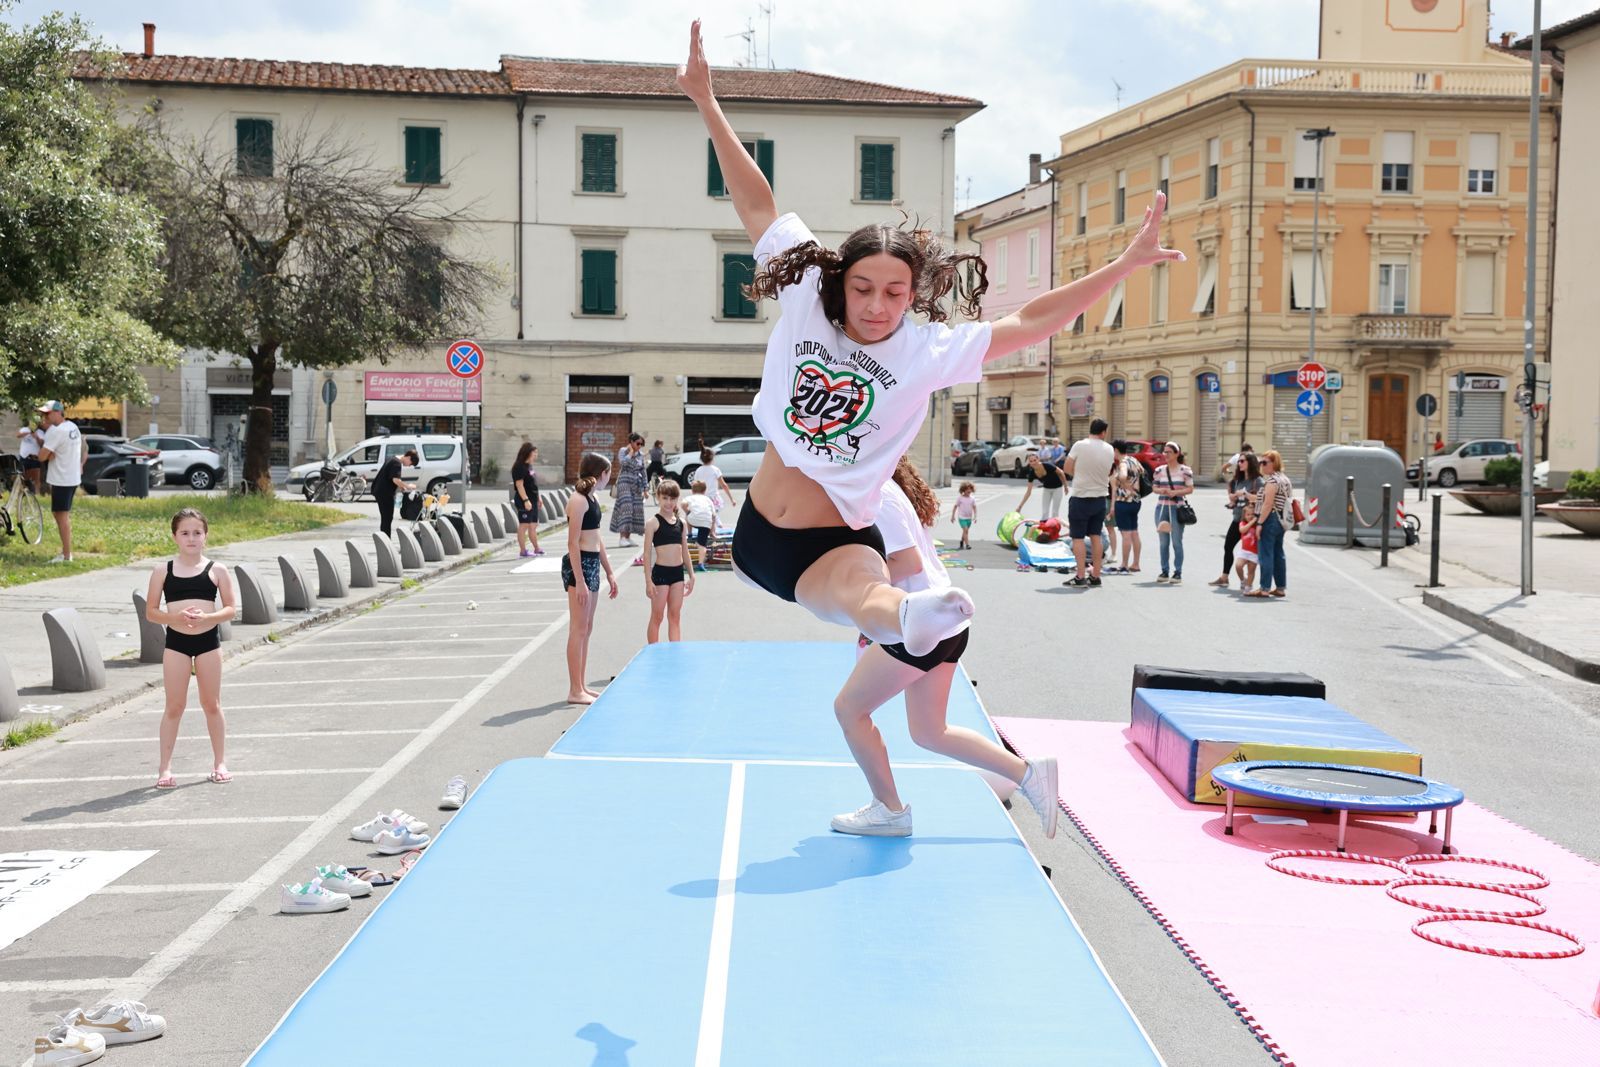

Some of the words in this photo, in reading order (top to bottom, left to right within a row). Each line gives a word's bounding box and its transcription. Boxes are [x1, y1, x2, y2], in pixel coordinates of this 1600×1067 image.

[850, 350, 898, 390] NAZIONALE
[1299, 370, 1325, 381] STOP
[370, 375, 422, 387] EMPORIO
[1210, 381, 1218, 392] P
[790, 385, 864, 425] 2025
